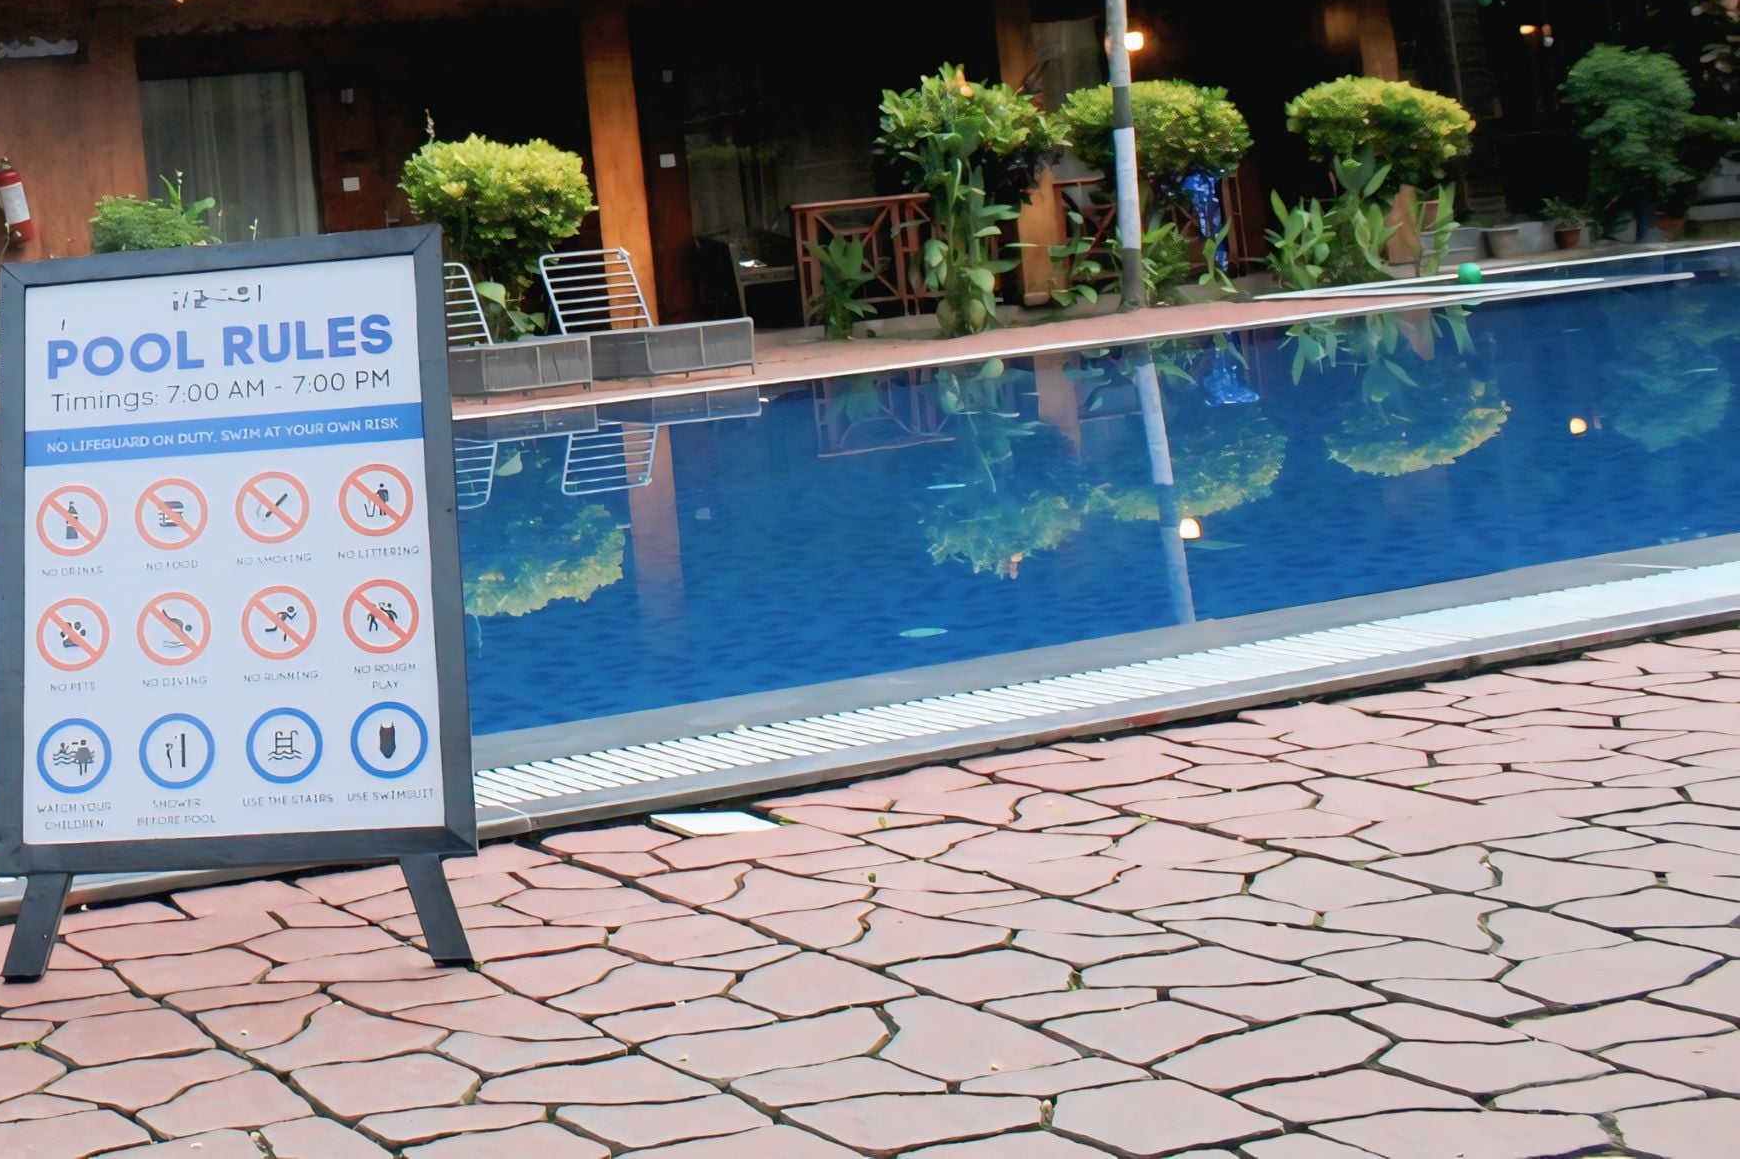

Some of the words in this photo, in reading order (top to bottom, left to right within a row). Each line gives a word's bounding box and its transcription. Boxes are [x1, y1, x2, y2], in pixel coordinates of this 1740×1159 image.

[47, 330, 205, 380] POOL
[222, 313, 393, 367] RULES
[51, 390, 159, 412] Timings:
[166, 382, 219, 404] 7:00
[227, 378, 265, 399] AM
[292, 372, 345, 395] 7:00
[355, 368, 390, 390] PM
[46, 441, 68, 453] NO
[71, 436, 150, 452] LIFEGUARD
[152, 434, 174, 446] ON
[220, 428, 261, 441] SWIM
[264, 426, 282, 438] AT
[285, 423, 324, 436] YOUR
[327, 420, 361, 433] OWN
[364, 417, 399, 430] RISK
[338, 549, 355, 559] NO
[358, 545, 420, 558] LITTERING
[145, 561, 163, 571] NO
[236, 555, 253, 566] NO
[353, 665, 371, 675] NO
[374, 662, 416, 674] ROUGH
[162, 675, 208, 687] DIVING
[243, 673, 261, 683] NO
[372, 679, 399, 690] PLAY
[50, 683, 67, 692] NO
[347, 791, 369, 802] USE
[372, 787, 436, 801] SWIMSUIT
[36, 802, 77, 814] WATCH
[80, 801, 112, 813] YOUR
[242, 797, 263, 807] USE
[267, 796, 288, 806] THE
[44, 818, 104, 831] CHILDREN
